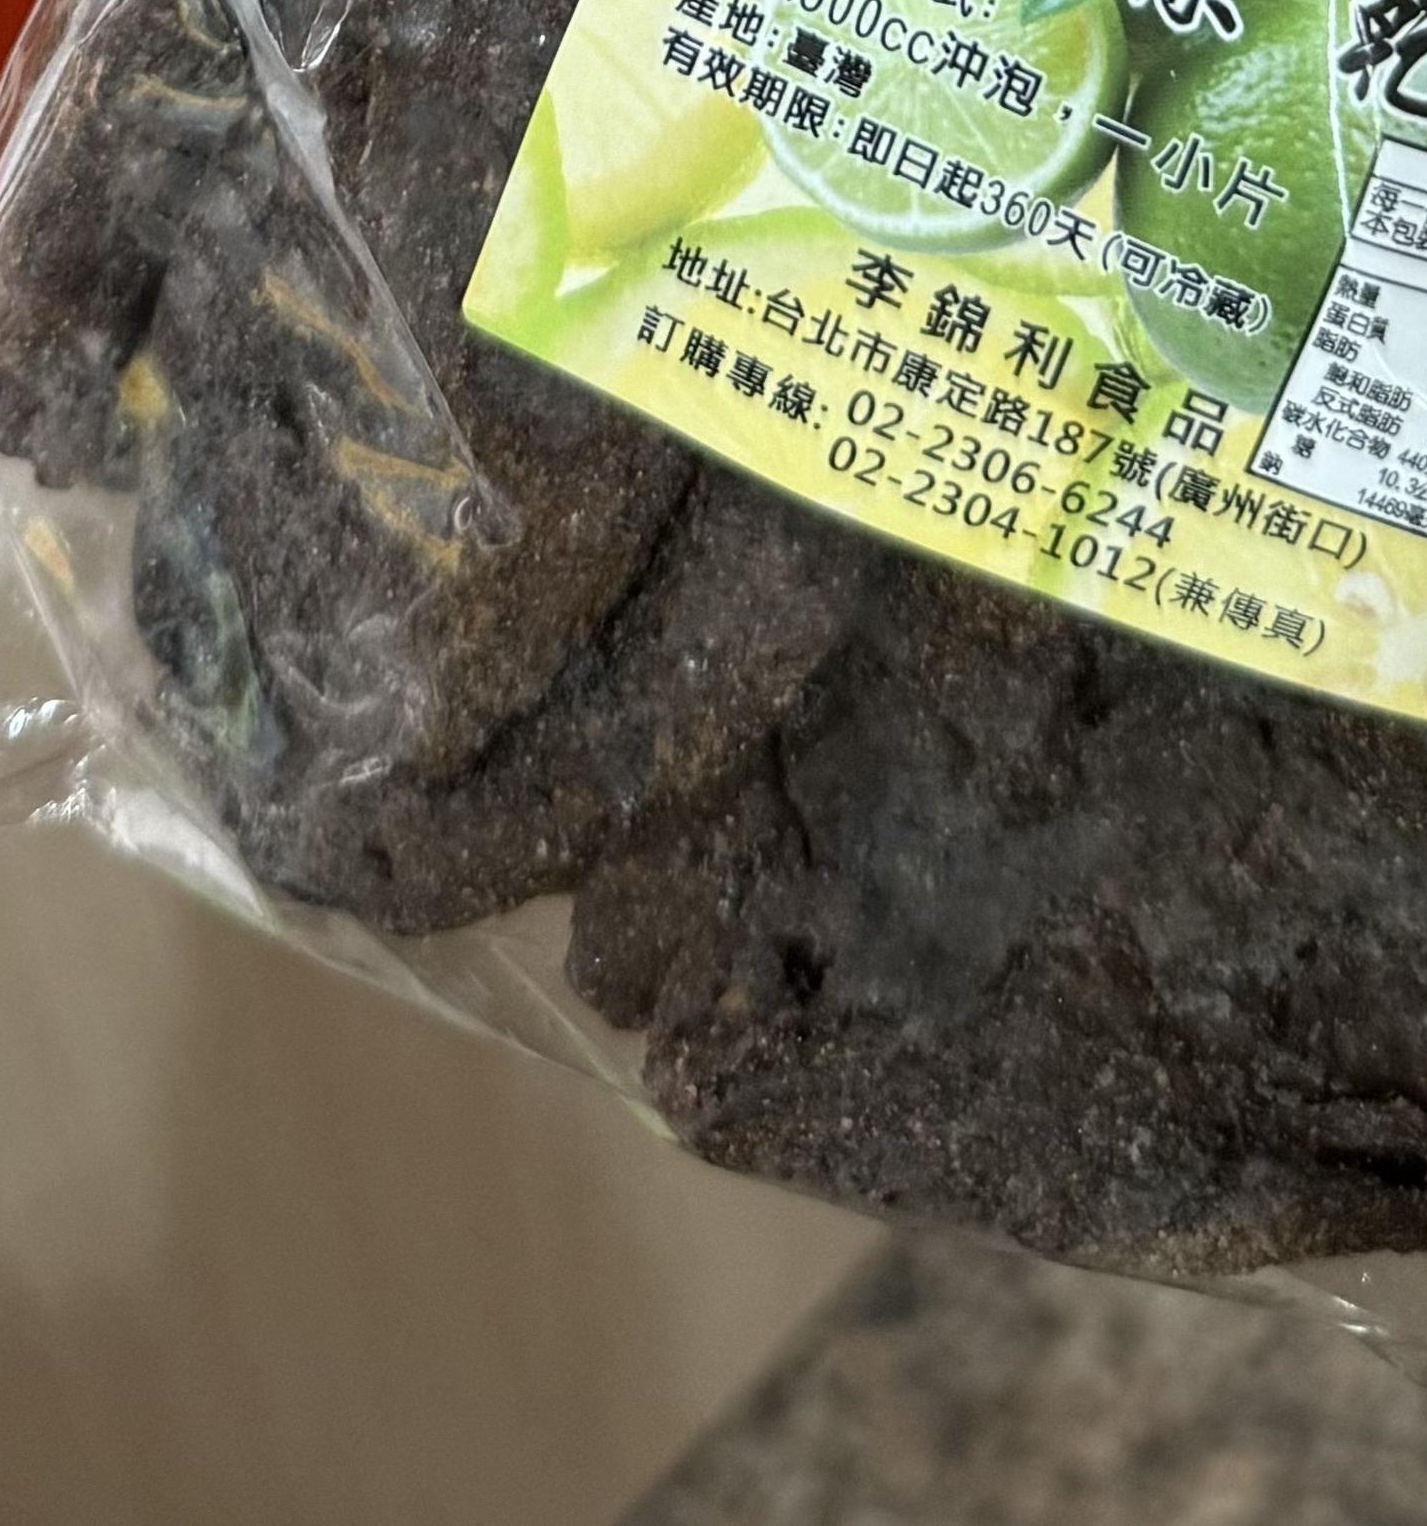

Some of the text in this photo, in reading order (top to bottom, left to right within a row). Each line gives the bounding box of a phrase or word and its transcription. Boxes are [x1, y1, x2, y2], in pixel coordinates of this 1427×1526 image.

[1333, 274, 1382, 310] 熱量
[1311, 329, 1362, 363] 脂肪
[1322, 301, 1392, 344] 蛋白質
[847, 251, 1228, 456] 李錦利食品
[1279, 399, 1394, 461] 碳水化合物
[1310, 385, 1405, 437] 反式脂肪
[847, 387, 1177, 550] 02-2306-6244
[827, 437, 1329, 659] 02-2304-1012(兼傳真)
